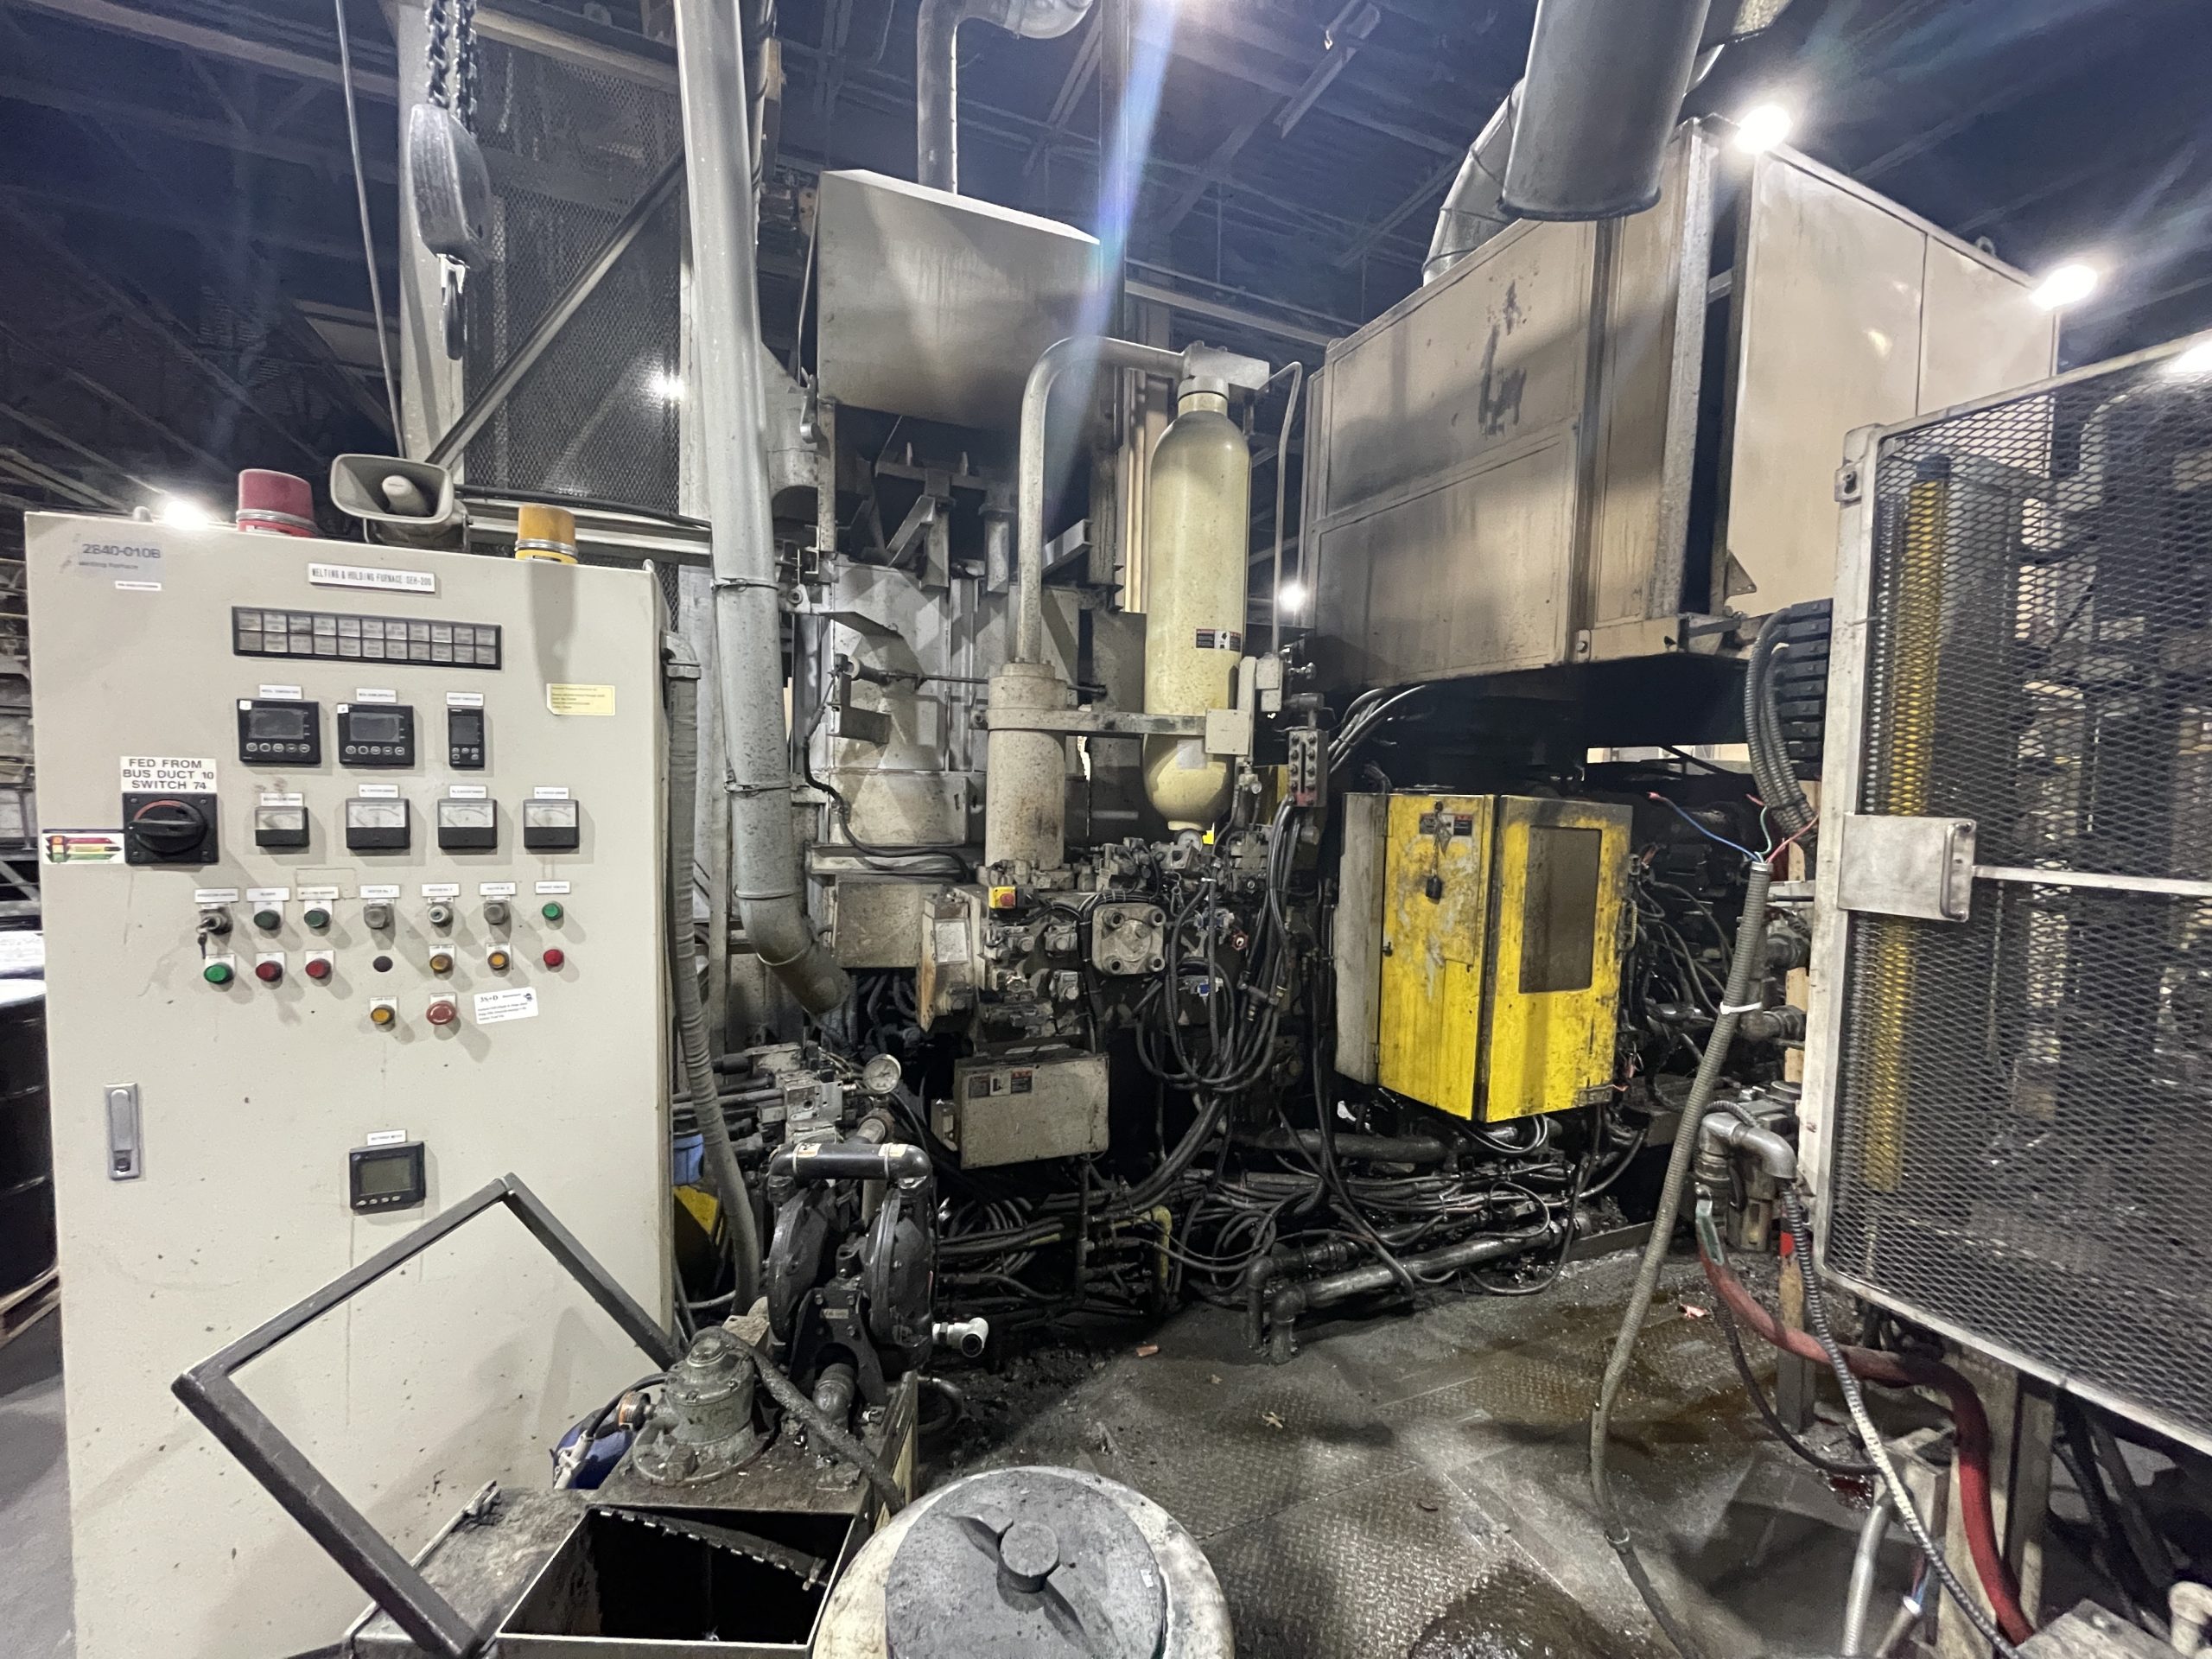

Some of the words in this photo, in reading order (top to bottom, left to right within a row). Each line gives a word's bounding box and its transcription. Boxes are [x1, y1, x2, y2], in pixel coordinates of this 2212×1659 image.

[312, 568, 339, 578] MELTING
[347, 571, 374, 581] HOLDING
[377, 573, 403, 584] FURNACE
[129, 759, 156, 767] FED
[162, 760, 202, 768] FROM
[123, 769, 151, 778] BUS
[156, 770, 195, 779] DUCT
[131, 779, 187, 789] SWITCH
[193, 781, 207, 790] 74
